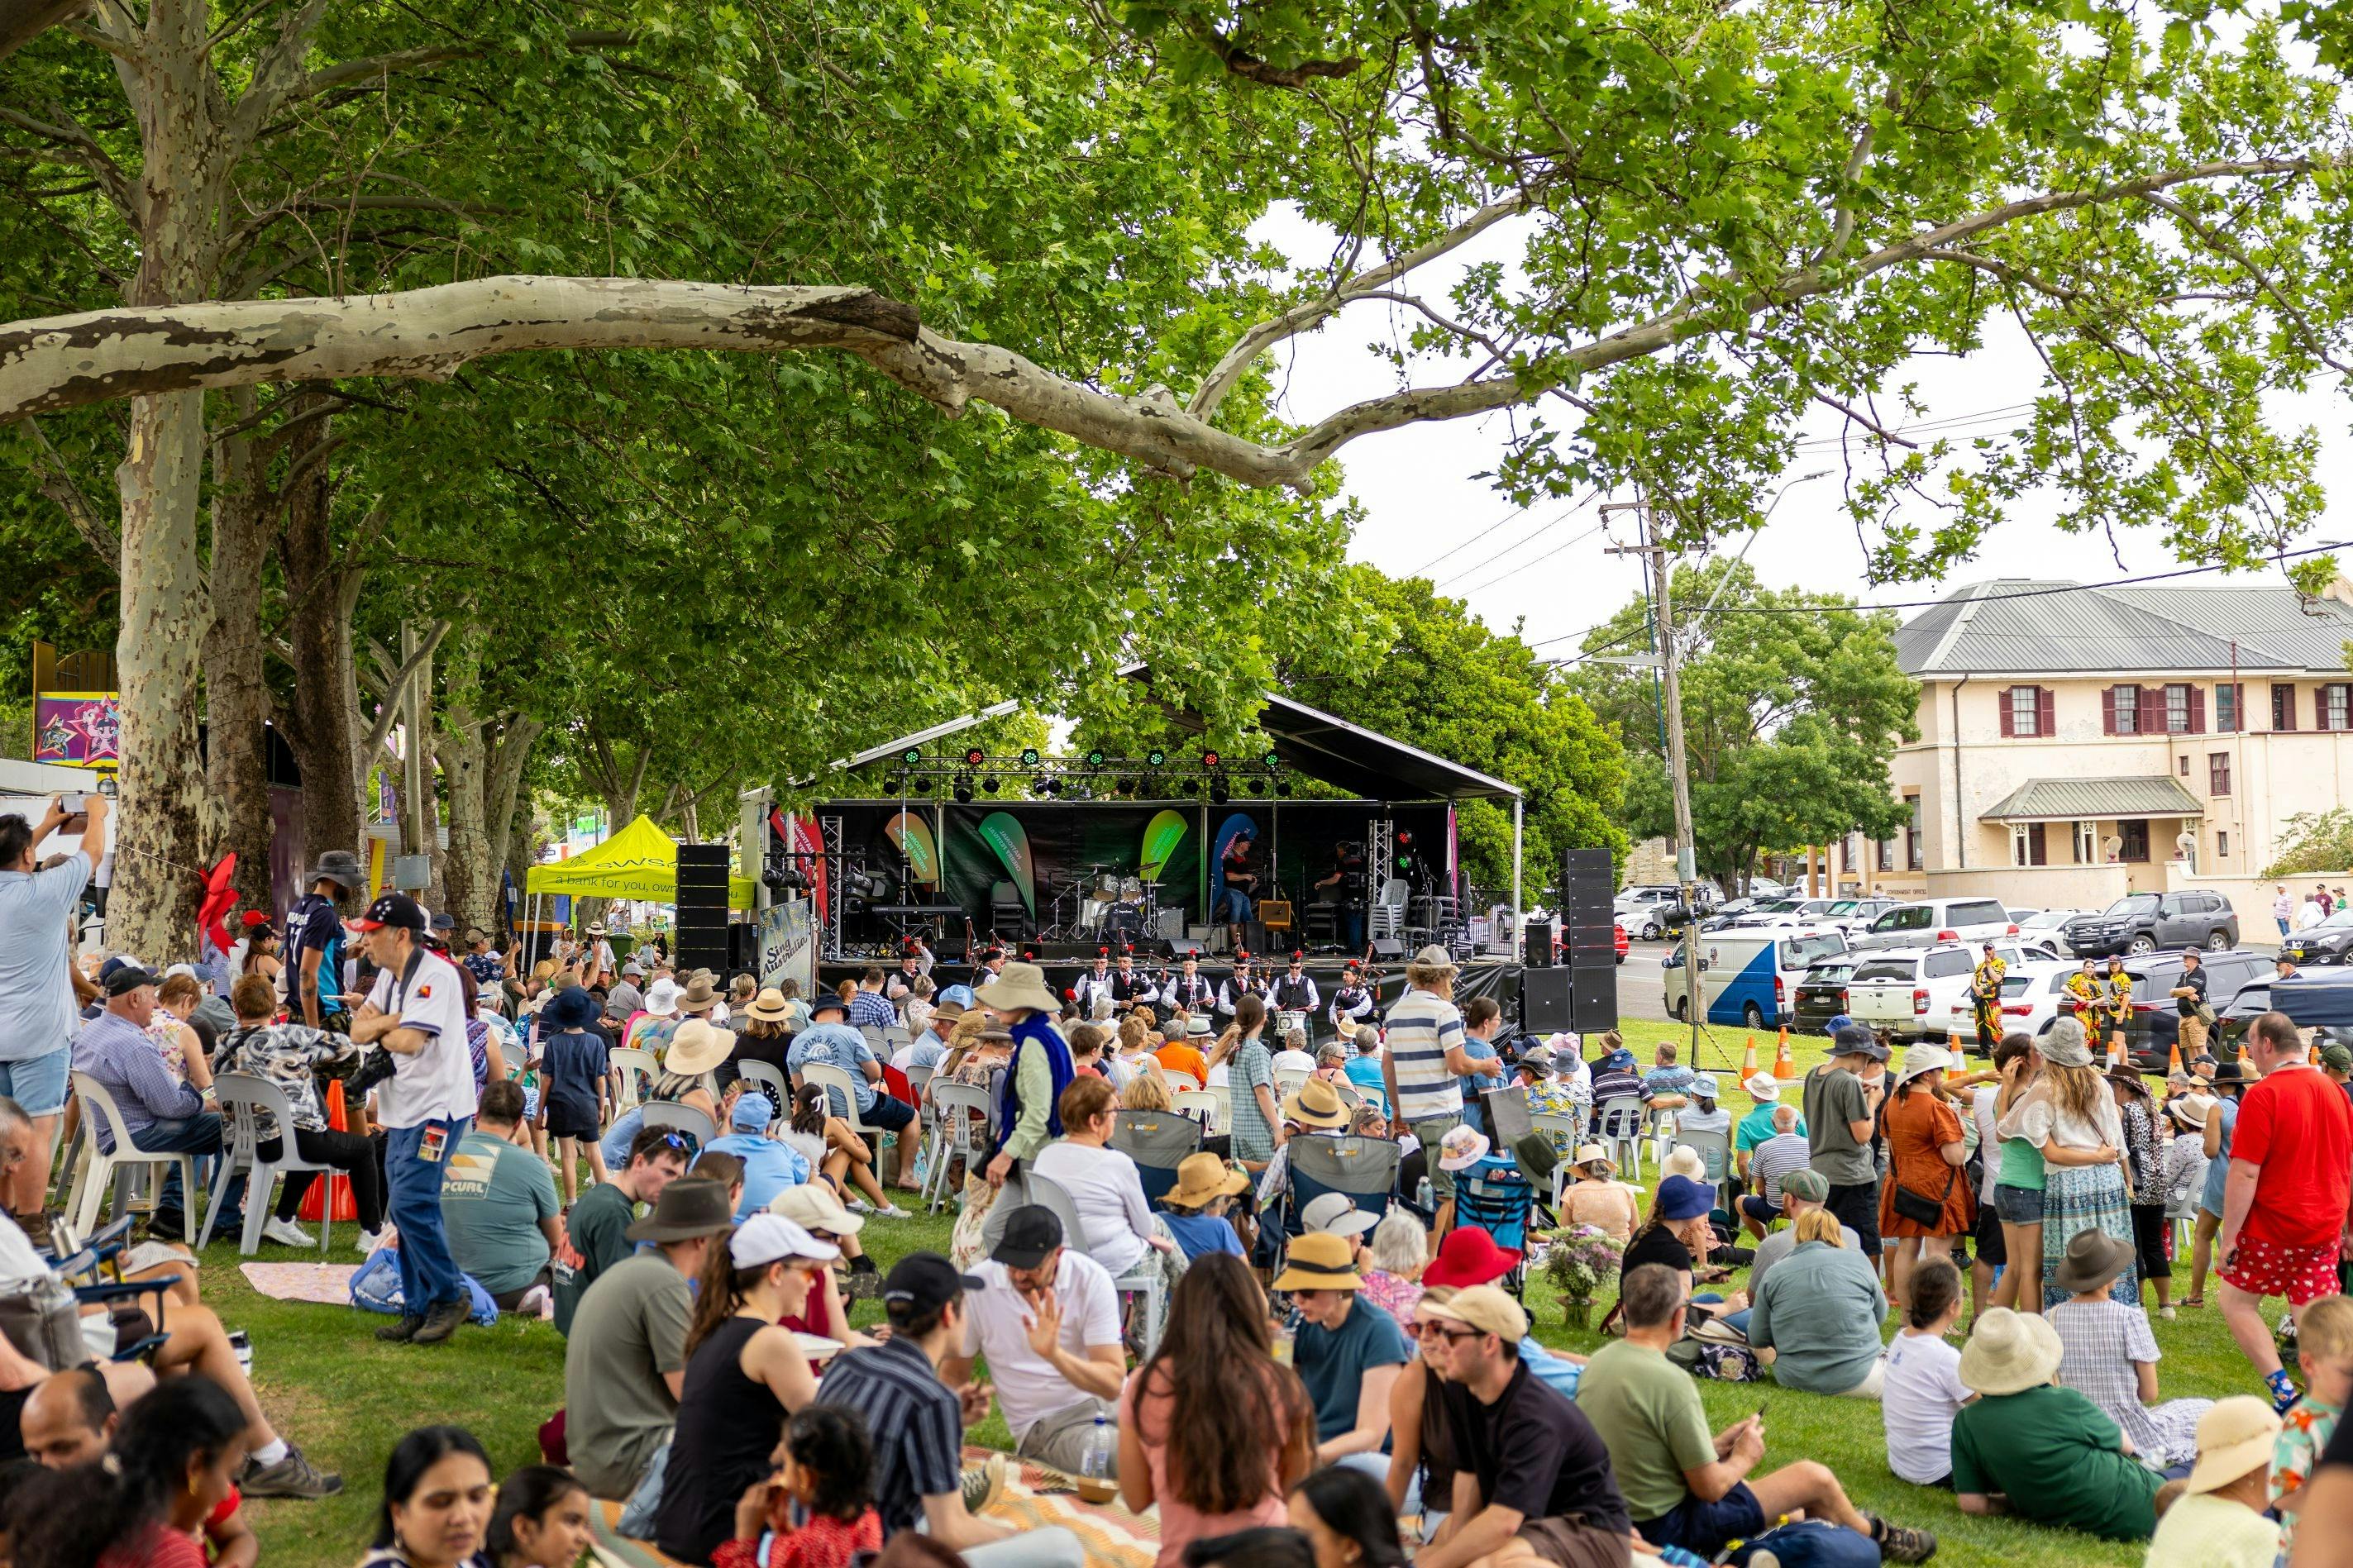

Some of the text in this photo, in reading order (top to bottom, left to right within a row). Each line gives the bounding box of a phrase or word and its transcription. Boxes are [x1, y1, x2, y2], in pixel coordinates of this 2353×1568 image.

[1220, 832, 1240, 860] NATIONAL
[556, 875, 563, 884] a
[567, 875, 597, 887] bank
[602, 877, 620, 888] for
[623, 881, 649, 893] you,
[760, 936, 808, 984] Australia
[767, 938, 791, 965] Sing
[800, 1036, 840, 1058] PIPING HOT
